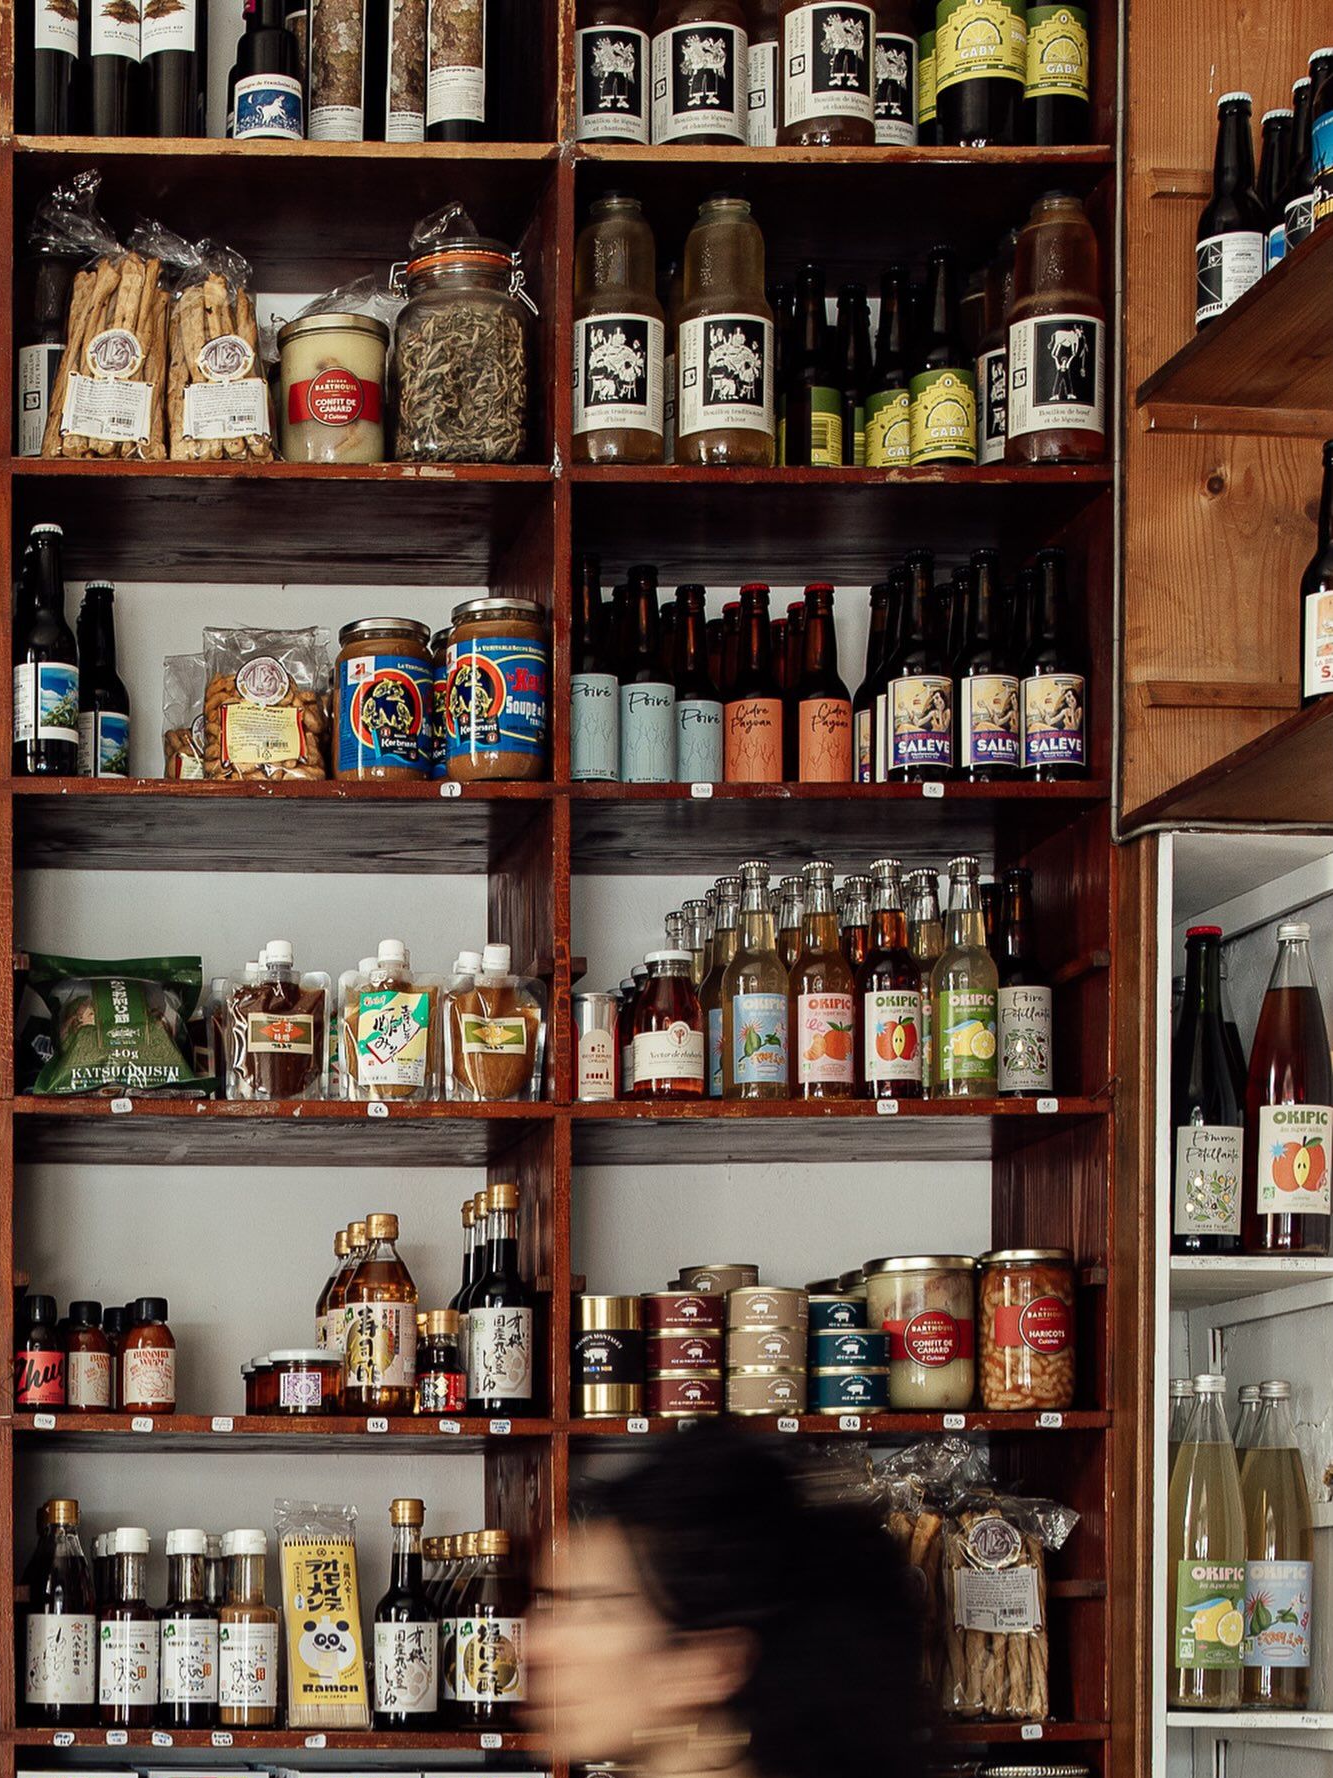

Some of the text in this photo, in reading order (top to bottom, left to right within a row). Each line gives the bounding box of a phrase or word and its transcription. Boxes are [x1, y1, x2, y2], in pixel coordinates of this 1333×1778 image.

[960, 46, 997, 58] GABY
[1046, 63, 1079, 74] GABY
[315, 398, 357, 407] CONFIT DE
[318, 405, 352, 413] CANARD
[930, 427, 965, 438] GABY
[628, 691, 671, 714] Poiré
[736, 702, 770, 716] Cidre
[680, 708, 721, 726] Poiré
[875, 995, 919, 1008] OKIPIC
[949, 994, 995, 1007] OKIPIC
[1011, 989, 1044, 1005] Poire
[808, 998, 852, 1011] OKIPIC
[111, 1049, 139, 1060] 40g
[71, 1066, 180, 1080] KATSUOBUSHI
[1272, 1110, 1328, 1126] OKIPIC
[1192, 1130, 1237, 1147] Pomme
[506, 1311, 527, 1350] 有機
[1028, 1329, 1065, 1338] HARICOTS
[356, 1307, 380, 1385] 寿司酢
[912, 1338, 953, 1348] CONFIT DE
[916, 1346, 950, 1355] CANARD
[1191, 1566, 1244, 1581] OKIPIC
[1249, 1565, 1307, 1580] OKIPIC
[307, 1559, 324, 1613] ラーメン
[407, 1626, 427, 1664] 有機
[302, 1682, 359, 1694] Ramen
